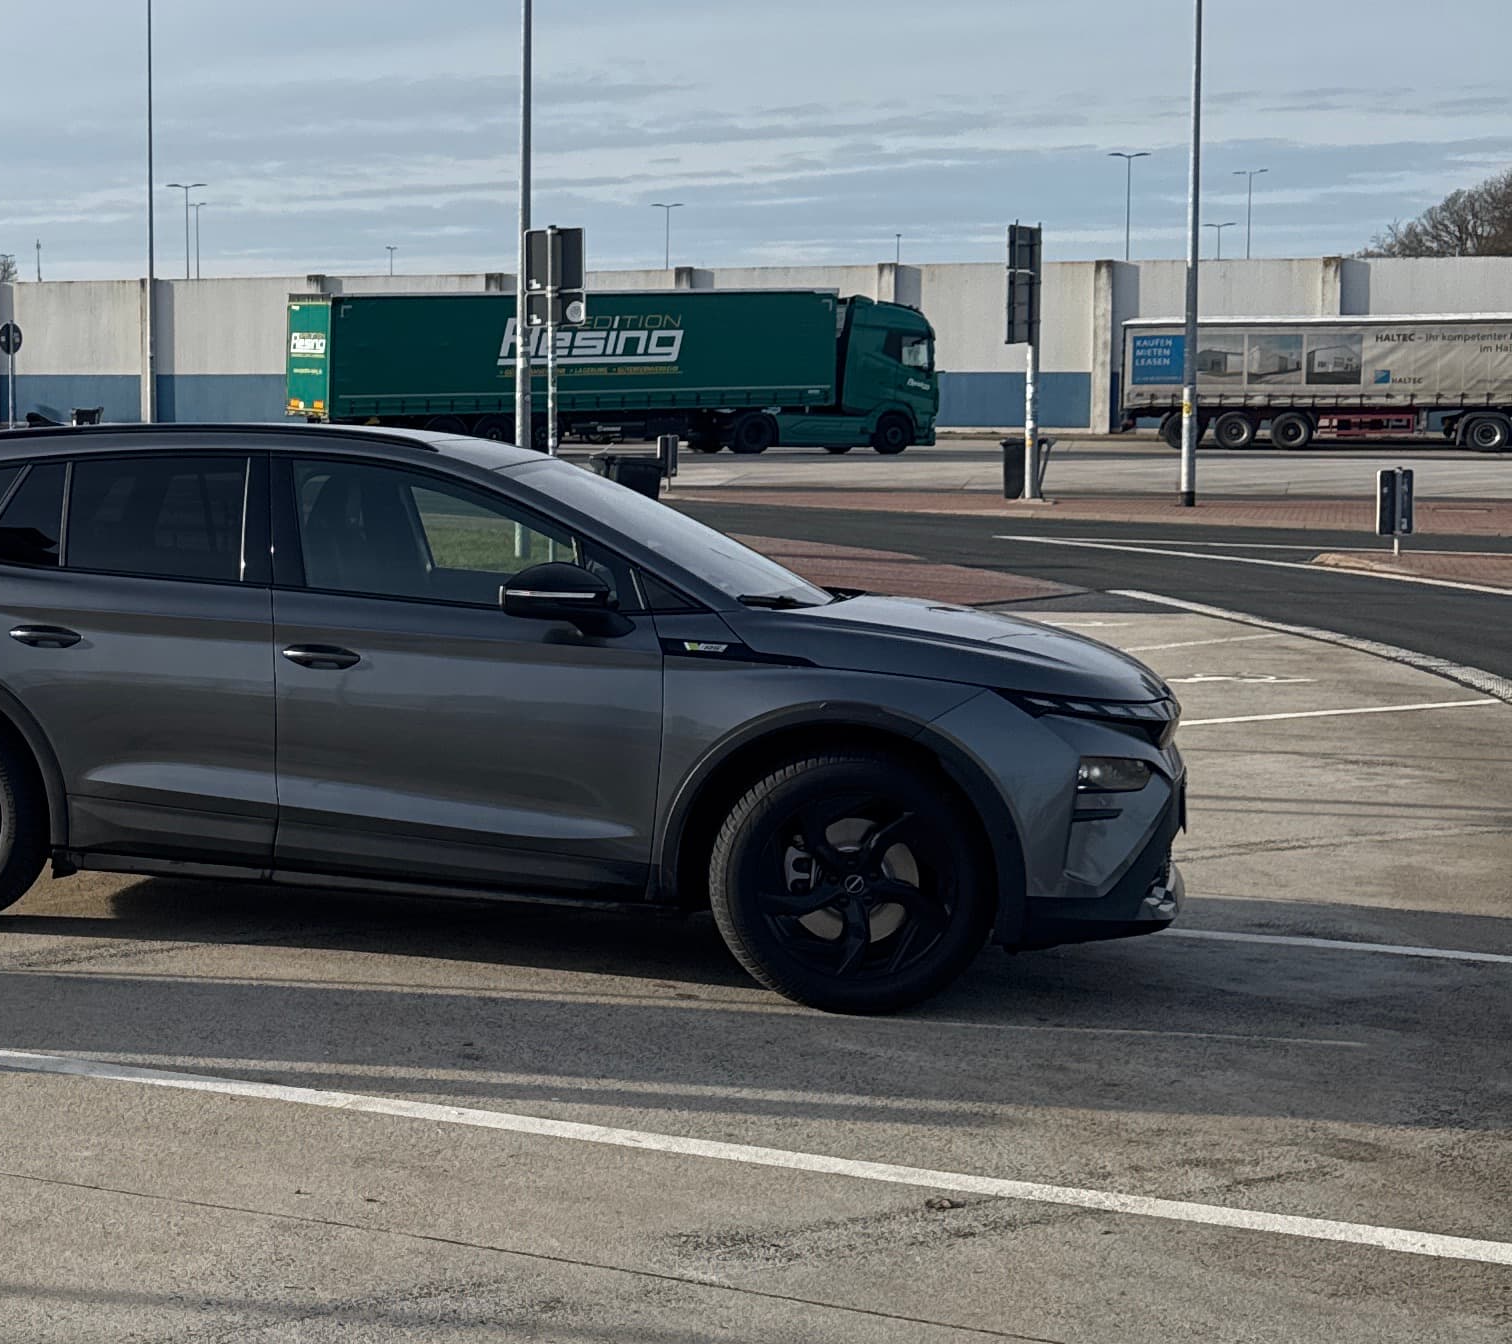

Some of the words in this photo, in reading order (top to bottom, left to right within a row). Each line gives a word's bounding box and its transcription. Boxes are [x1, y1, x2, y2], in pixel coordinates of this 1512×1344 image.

[1376, 333, 1415, 342] HALTEC
[1426, 333, 1438, 342] Ihr
[1442, 332, 1507, 343] kompetenter
[1136, 338, 1173, 347] KAUFEN
[1136, 348, 1171, 356] MIETEN
[1136, 357, 1171, 366] LEASEN
